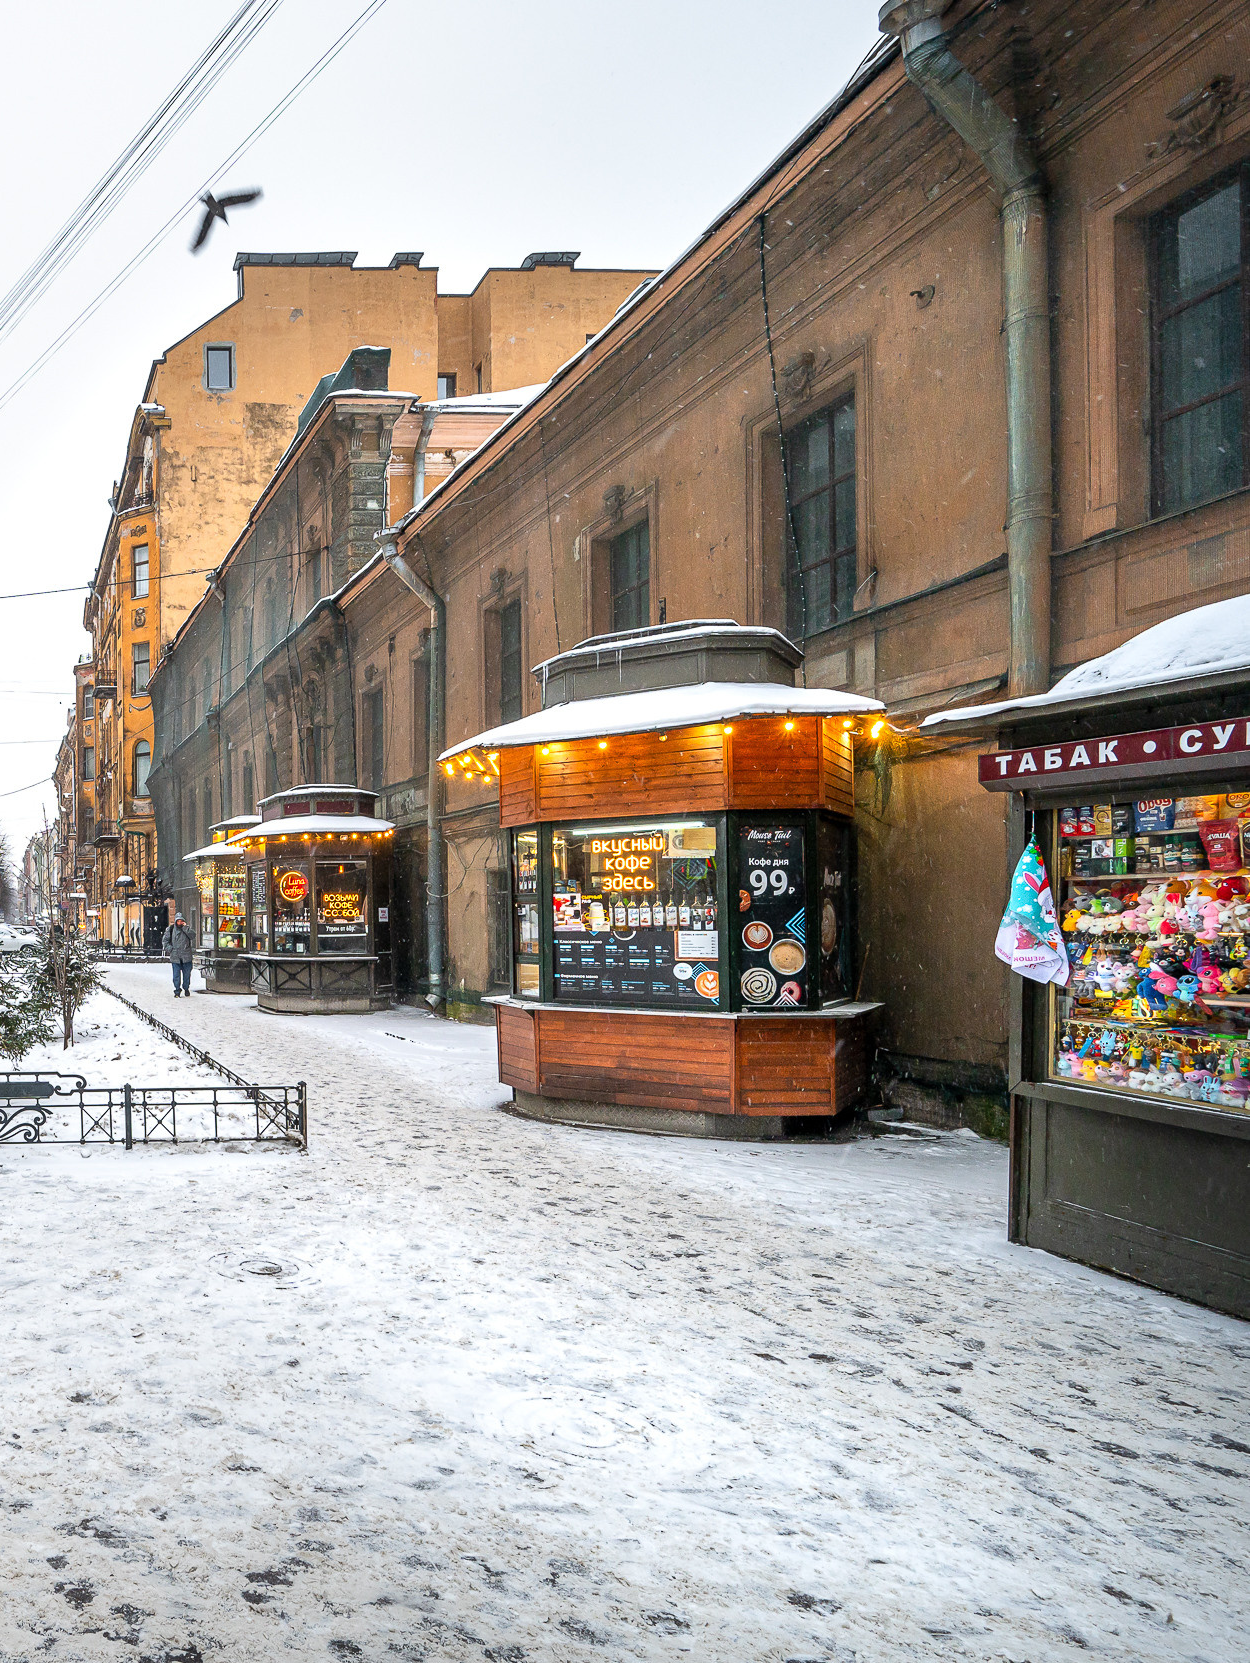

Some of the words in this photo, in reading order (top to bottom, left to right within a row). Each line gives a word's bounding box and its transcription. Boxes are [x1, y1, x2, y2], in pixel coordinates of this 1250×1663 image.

[995, 740, 1119, 776] ТАБАК
[1179, 722, 1250, 753] СУ
[591, 833, 665, 857] вкусный
[604, 855, 651, 872] кофе
[748, 857, 771, 867] Кофе
[772, 859, 789, 867] дня
[288, 876, 305, 886] Luna
[602, 873, 655, 891] здесь
[284, 886, 304, 897] coffee
[324, 894, 358, 902] ВОЗЬМИ
